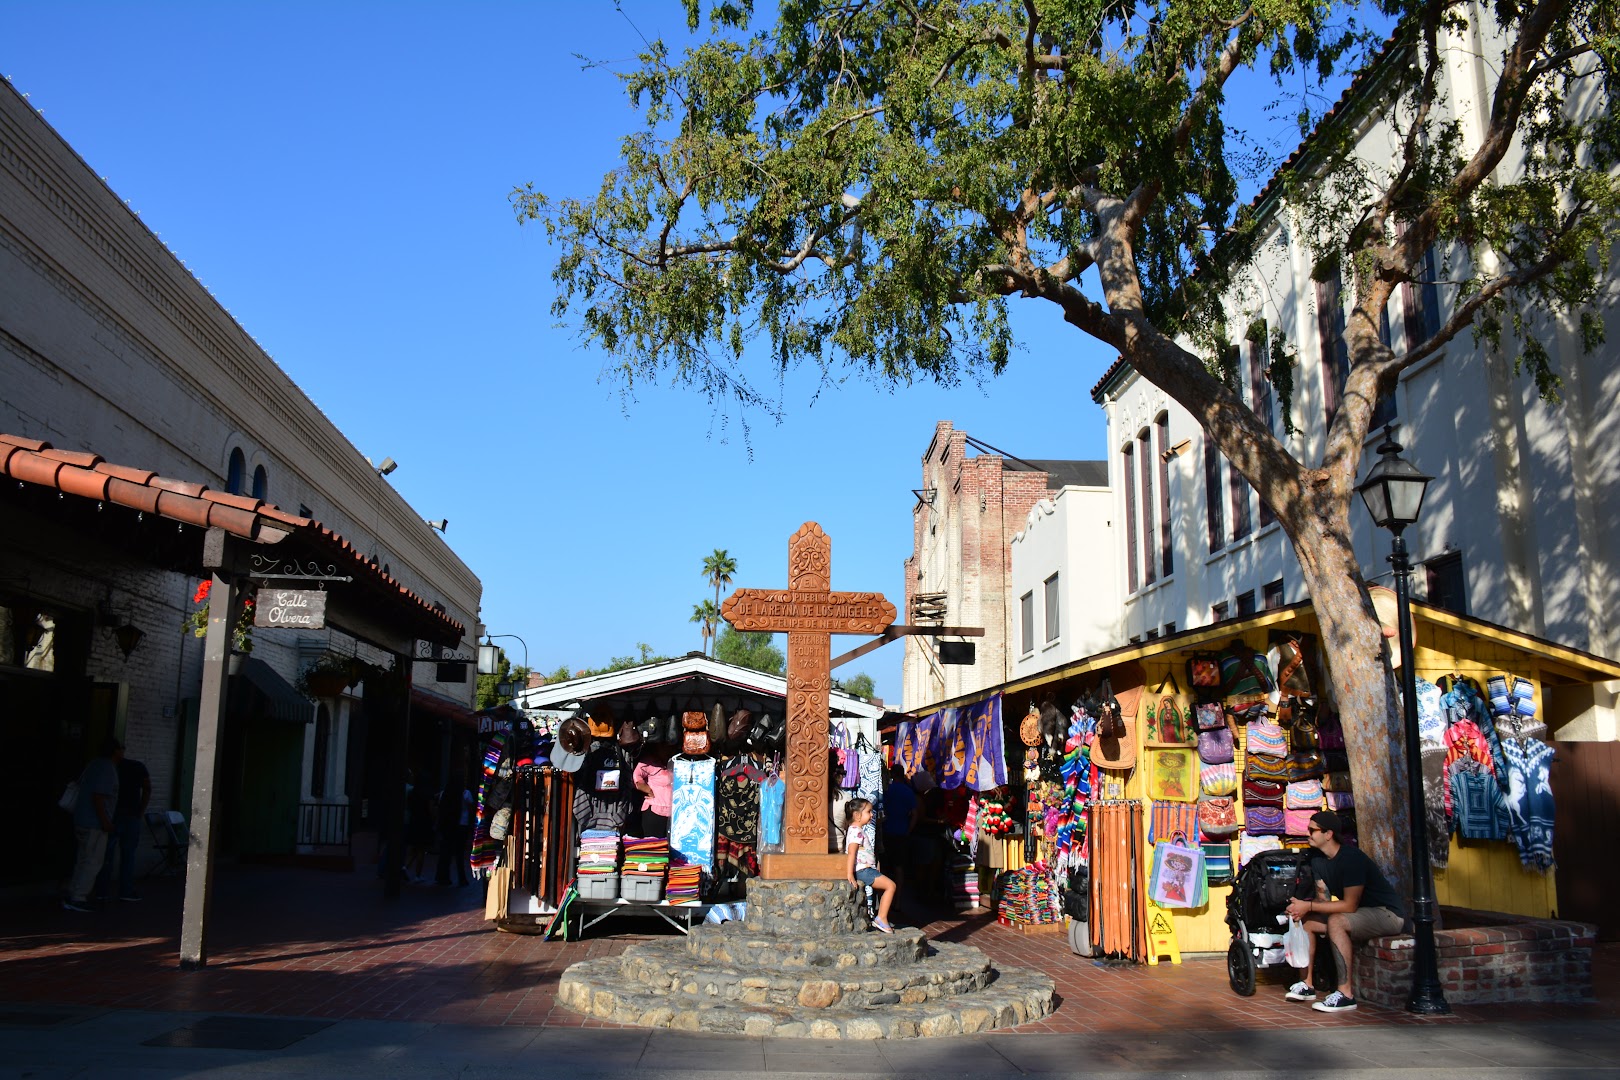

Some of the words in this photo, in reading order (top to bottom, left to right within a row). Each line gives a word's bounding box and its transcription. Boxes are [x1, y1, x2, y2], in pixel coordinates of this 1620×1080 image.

[804, 578, 817, 588] EL
[277, 592, 307, 607] Calle
[269, 607, 310, 623] Olvera
[739, 603, 752, 616] DE
[755, 604, 769, 616] LA
[770, 604, 799, 617] REYNA
[802, 605, 813, 617] DE
[816, 605, 834, 618] LOS
[835, 606, 880, 619] ANGELES
[771, 619, 804, 628] FELIPE
[805, 620, 817, 629] DE
[820, 620, 846, 629] NEVE
[790, 635, 828, 645] SEPTEMBER
[794, 647, 825, 657] FOURTH
[799, 659, 819, 669] 1781
